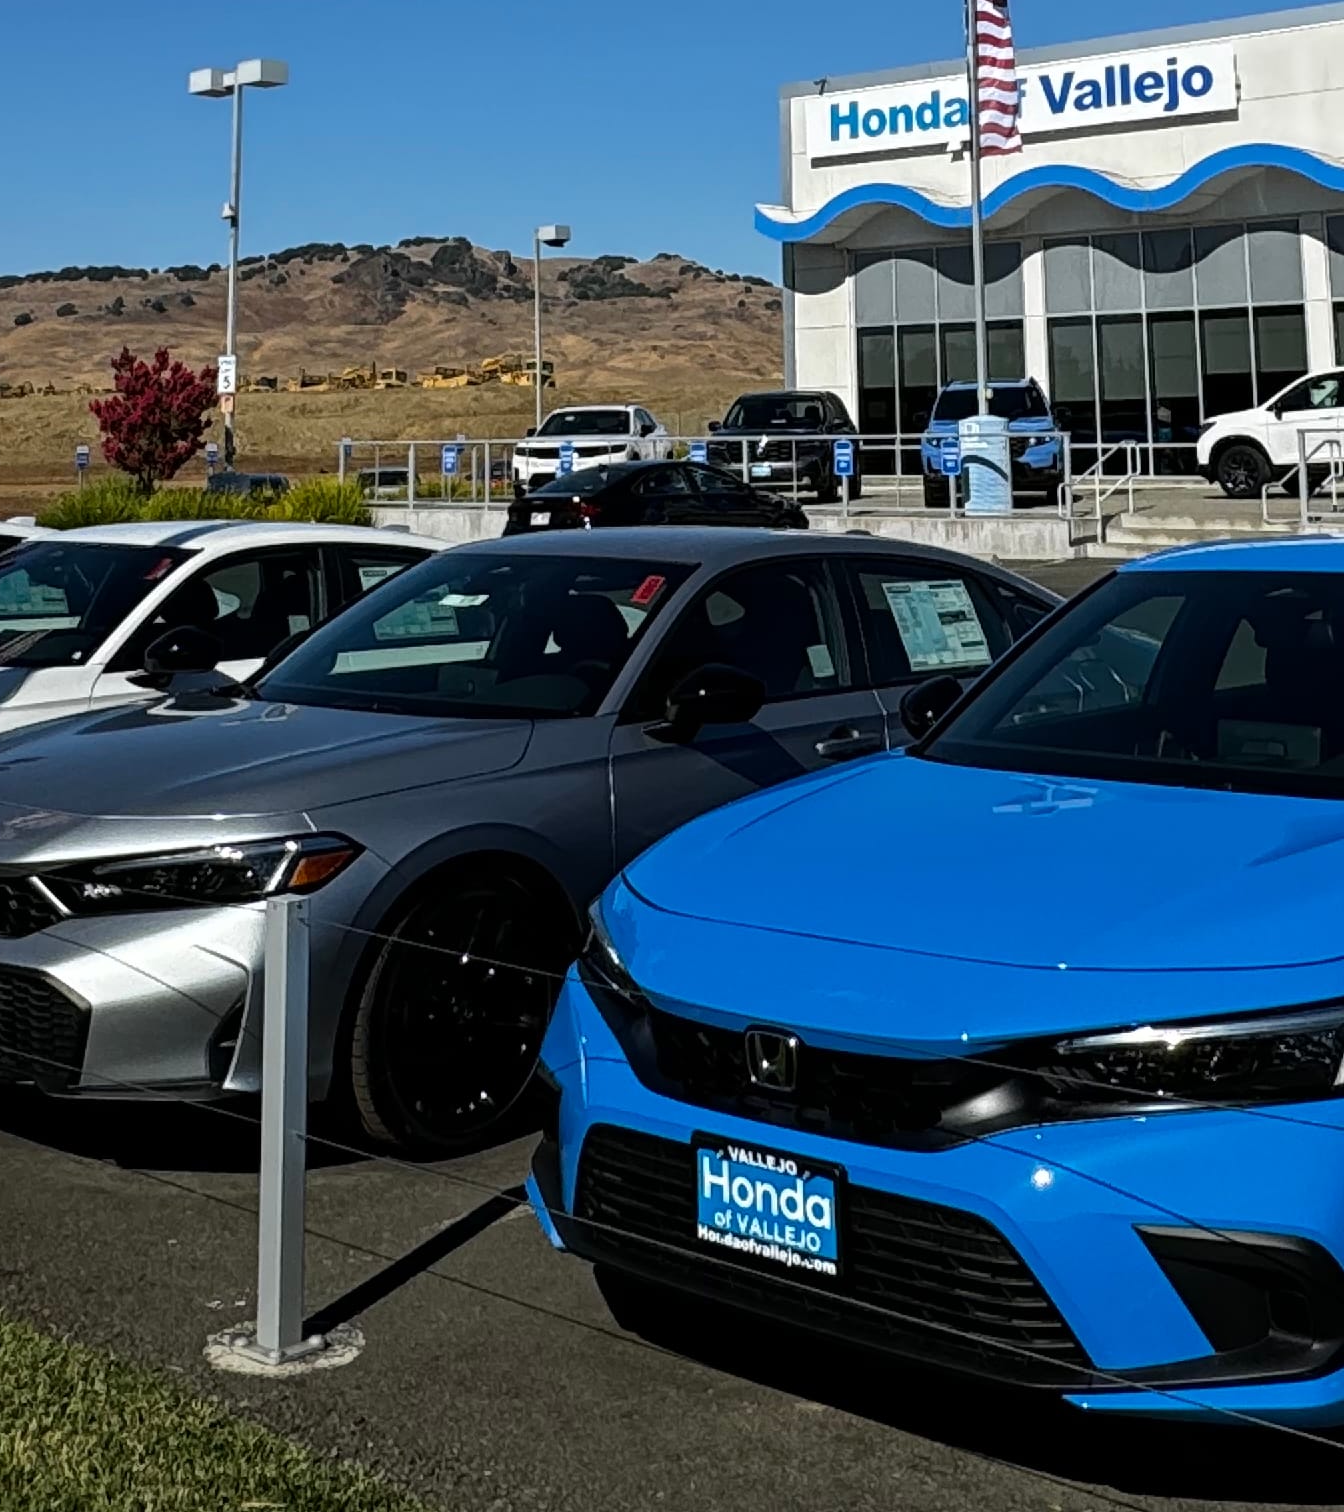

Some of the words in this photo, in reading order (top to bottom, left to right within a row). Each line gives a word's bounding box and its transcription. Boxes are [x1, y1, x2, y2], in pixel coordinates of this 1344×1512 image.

[830, 90, 969, 141] Honda
[1039, 57, 1214, 113] Vallejo
[727, 1145, 798, 1176] VALLEJO
[702, 1156, 832, 1230] Honda
[714, 1209, 733, 1229] of
[737, 1212, 822, 1253] VALLEJO
